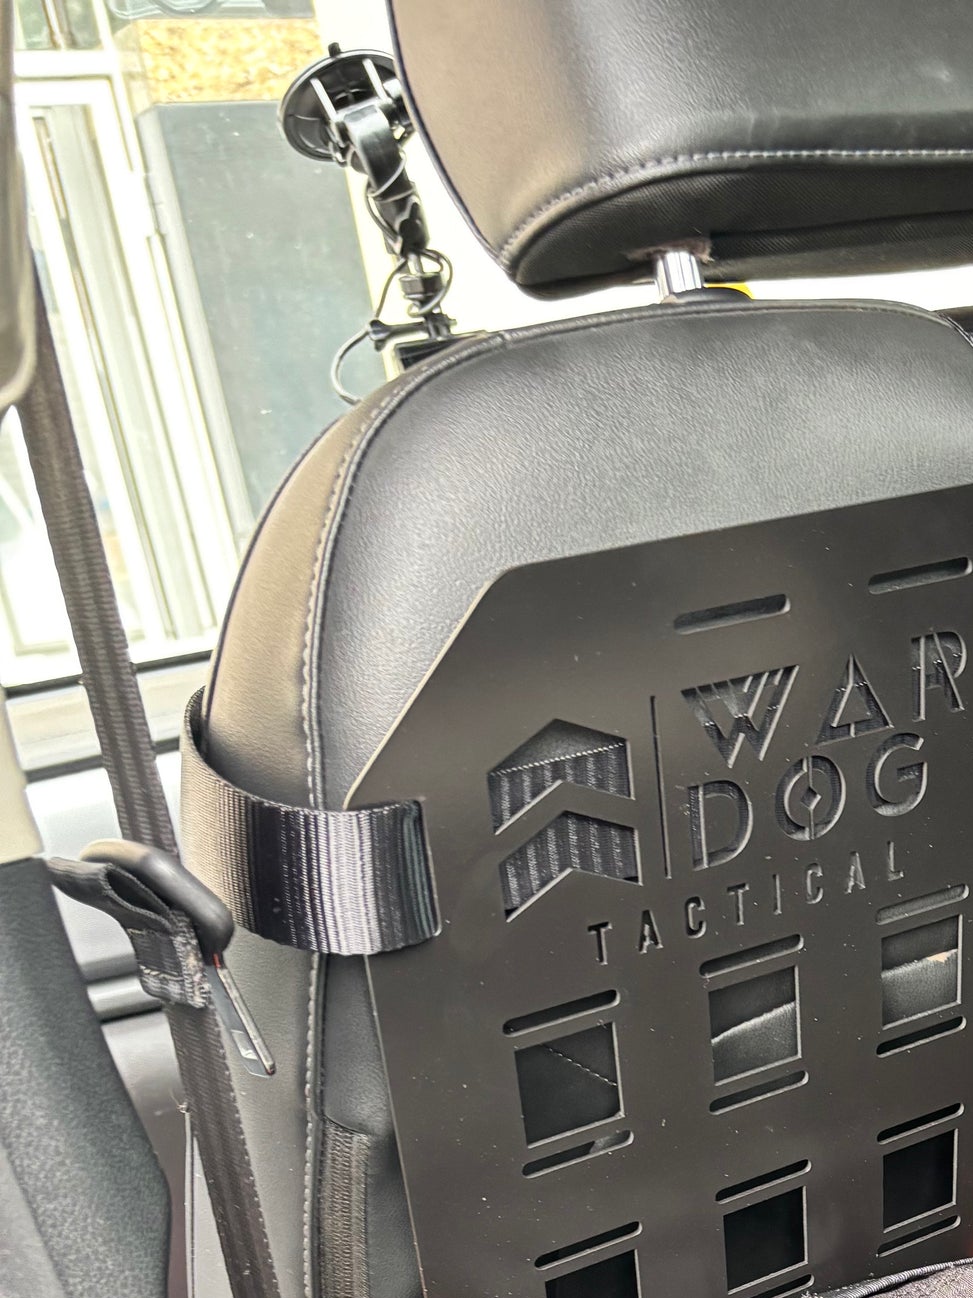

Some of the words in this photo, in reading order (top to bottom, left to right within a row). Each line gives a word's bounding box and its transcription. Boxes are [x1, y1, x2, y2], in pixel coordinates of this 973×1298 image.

[681, 631, 967, 768] WAR
[687, 732, 928, 871] DOG
[588, 840, 904, 965] TACTICAL
